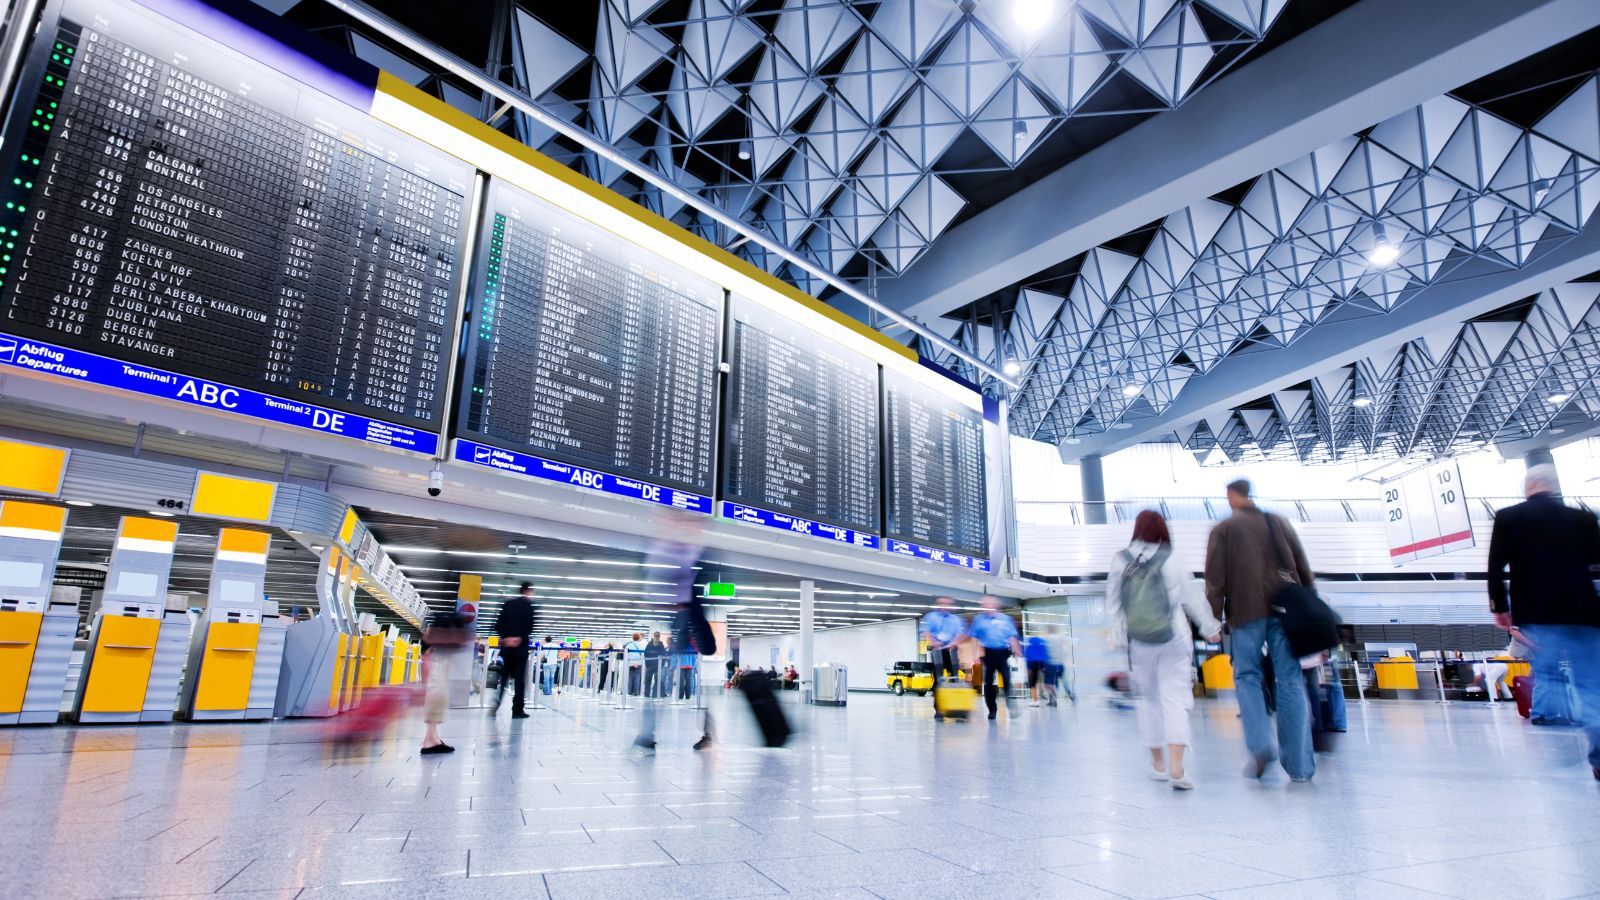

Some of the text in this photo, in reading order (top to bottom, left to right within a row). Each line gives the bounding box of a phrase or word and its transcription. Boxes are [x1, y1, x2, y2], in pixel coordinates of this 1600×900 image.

[83, 53, 90, 63] L
[164, 87, 223, 119] PORTLAND
[86, 42, 94, 52] L
[166, 77, 224, 109] HELSINKI
[169, 67, 227, 100] VARADERO
[74, 85, 81, 95] L
[80, 64, 87, 73] L
[161, 97, 197, 119] MIAMI
[61, 129, 70, 140] A
[104, 145, 128, 161] 875
[145, 160, 206, 190] MONTREAL
[64, 118, 72, 128] L
[107, 134, 131, 150] 494
[147, 150, 201, 177] CALGARY
[51, 163, 58, 173] L
[95, 179, 120, 194] 442
[136, 193, 191, 219] DETROIT
[54, 152, 62, 162] L
[98, 168, 122, 183] 456
[139, 182, 163, 198] LOS
[171, 193, 223, 218] ANGELES
[47, 175, 55, 185] L
[92, 190, 116, 206] 440
[133, 204, 188, 230] HOUSTON
[37, 210, 46, 221] O
[82, 224, 107, 240] 417
[124, 238, 173, 260] ZAGREB
[44, 187, 51, 197] L
[80, 199, 113, 217] 4726
[130, 215, 244, 260] LONDON-HEATHROW
[30, 234, 38, 245] L
[76, 248, 101, 263] 686
[118, 260, 143, 275] TEL
[152, 270, 183, 287] AVIV
[33, 223, 41, 233] L
[70, 234, 104, 252] 6808
[121, 249, 162, 269] KOELN
[170, 264, 193, 278] HBF
[19, 272, 28, 282] J
[67, 284, 92, 299] 117
[109, 295, 183, 322] LJUBLJANA
[22, 259, 30, 269] L
[70, 272, 95, 286] 176
[112, 284, 208, 317] BERLIN-TEGEL
[26, 246, 34, 257] L
[72, 260, 98, 274] 590
[116, 272, 157, 291] ADDIS
[165, 286, 267, 322] ABEBA-KHARTOUM
[11, 296, 20, 307] L
[49, 306, 85, 323] 3126
[103, 319, 153, 339] BERGEN
[15, 284, 23, 294] L
[53, 293, 88, 310] 4980
[106, 307, 156, 328] DUBLIN
[8, 309, 16, 320] L
[46, 318, 82, 335] 3160
[100, 331, 174, 357] STAVANGER
[17, 354, 88, 378] Departures
[20, 344, 64, 361] Abflug
[122, 365, 240, 408] Terminal 1 ABC
[536, 385, 572, 402] NUERNBERG
[534, 402, 563, 417] TORONTO
[535, 394, 564, 408] VILNIUS
[265, 398, 302, 414] Terminal
[312, 409, 345, 433] DE
[532, 420, 569, 436] AMSTERDAM
[533, 411, 565, 426] HELSINKI
[492, 450, 514, 462] Abflug
[530, 438, 555, 450] DUBLIN
[491, 458, 526, 473] Departures
[542, 461, 567, 474] Terminal
[570, 469, 603, 489] ABC
[1437, 470, 1451, 484] 10
[616, 478, 638, 489] Terminal
[642, 484, 660, 501] DE
[1386, 488, 1398, 503] 20
[1441, 490, 1455, 504] 10
[157, 499, 183, 509] 464
[1389, 508, 1402, 522] 20
[791, 519, 811, 534] ABC
[835, 528, 847, 541] DE
[930, 550, 944, 561] ABC
[960, 556, 968, 566] DE
